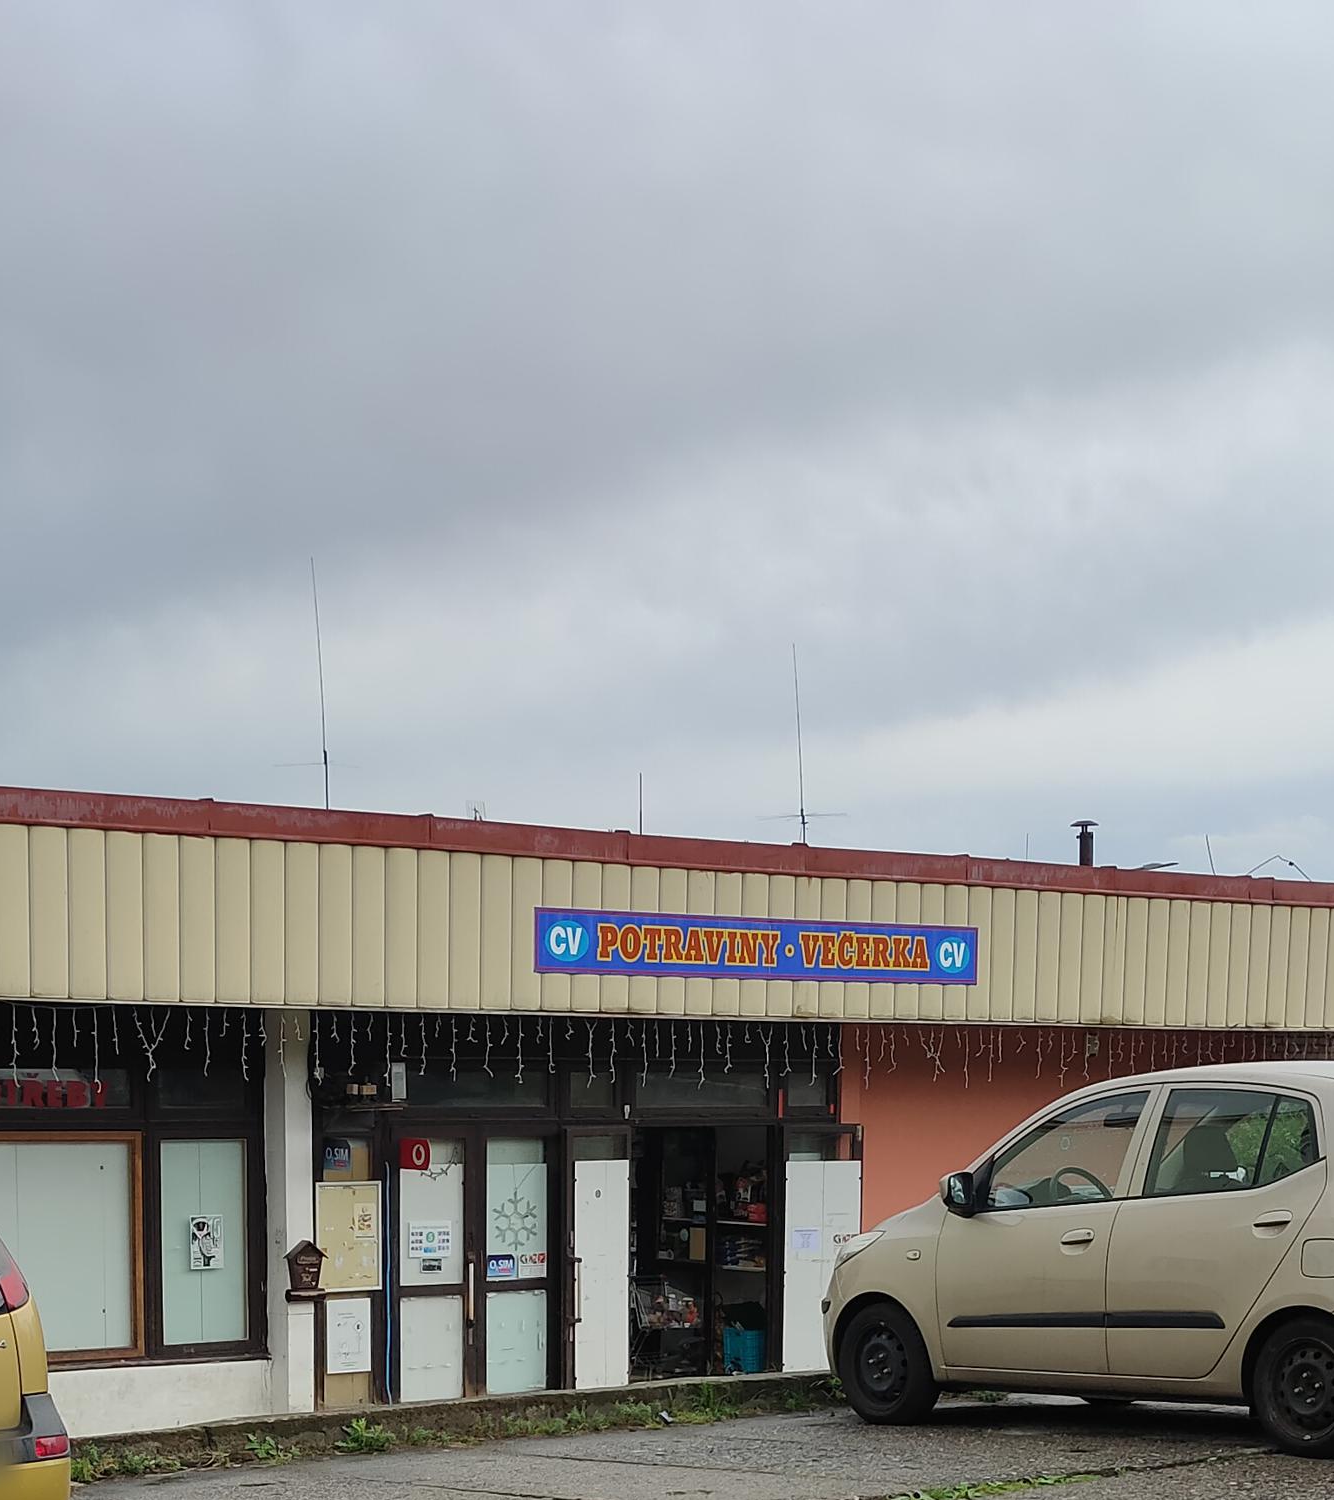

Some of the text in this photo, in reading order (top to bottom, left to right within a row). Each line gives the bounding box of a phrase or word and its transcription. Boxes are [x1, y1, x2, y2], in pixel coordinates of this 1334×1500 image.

[549, 923, 966, 971] CV POTRAVINY VEČERKA CV
